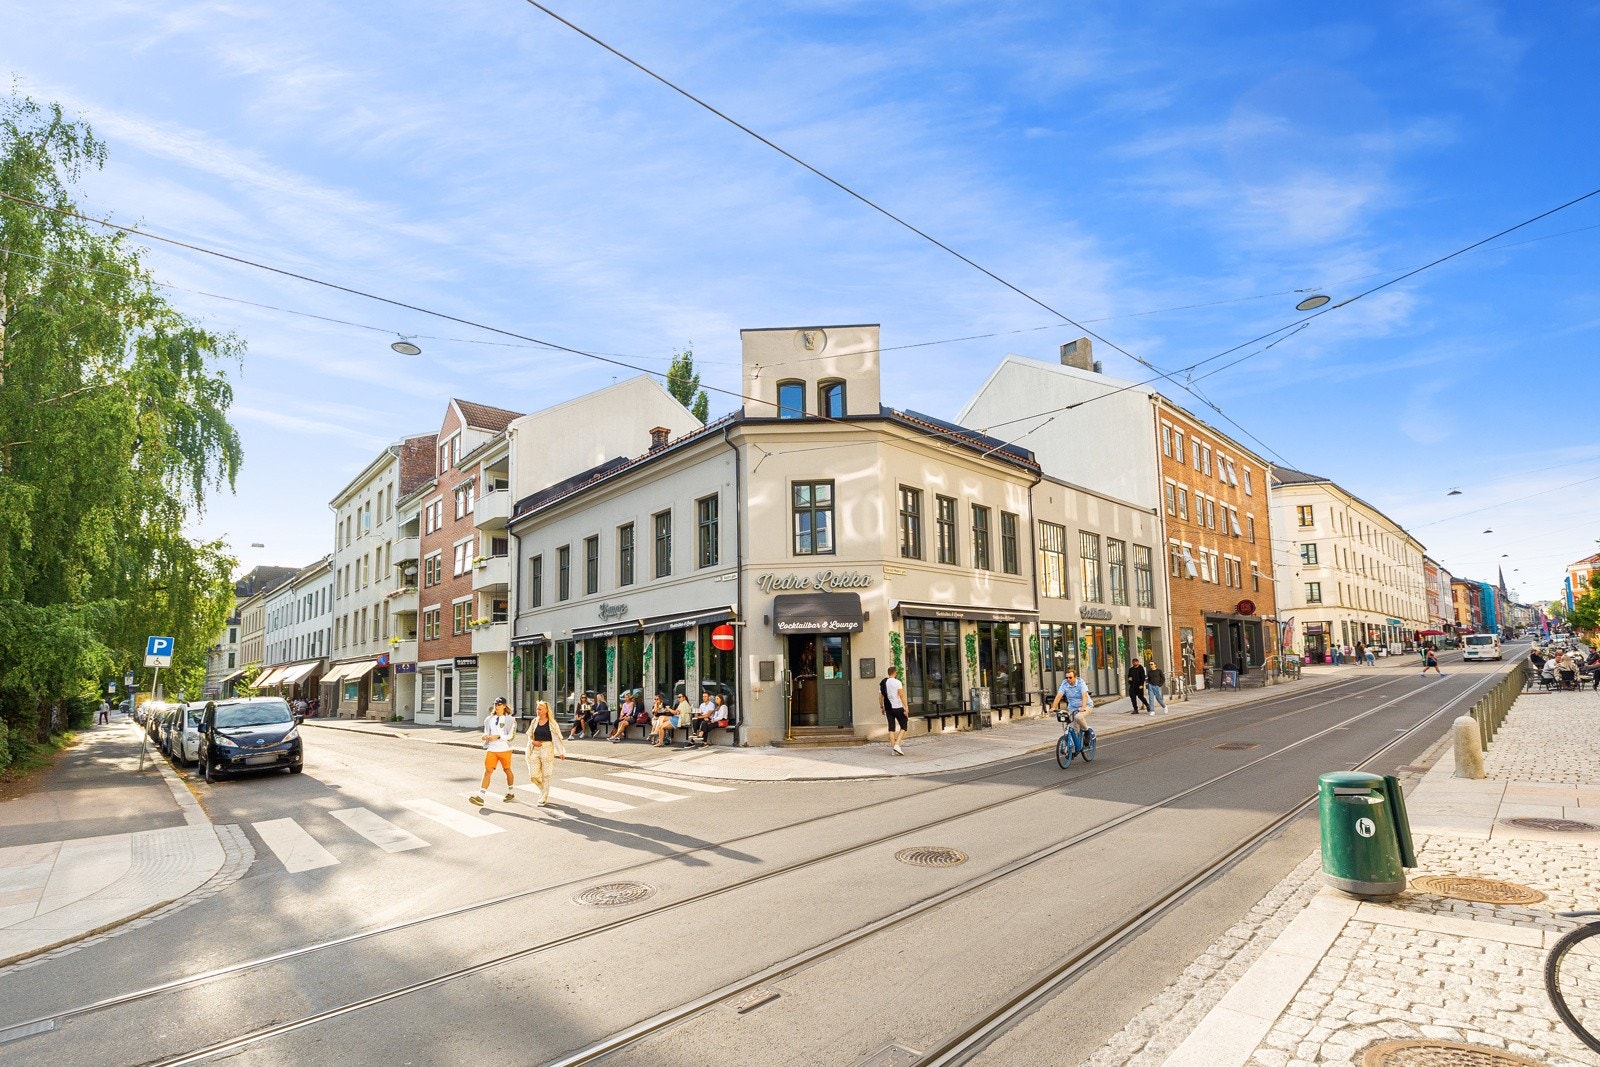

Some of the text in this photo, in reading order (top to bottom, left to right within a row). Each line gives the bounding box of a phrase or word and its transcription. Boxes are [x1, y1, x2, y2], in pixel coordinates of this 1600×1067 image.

[757, 573, 811, 594] Nedre
[778, 621, 820, 630] Cocktailbar
[829, 620, 858, 630] Lounge
[153, 639, 168, 654] P
